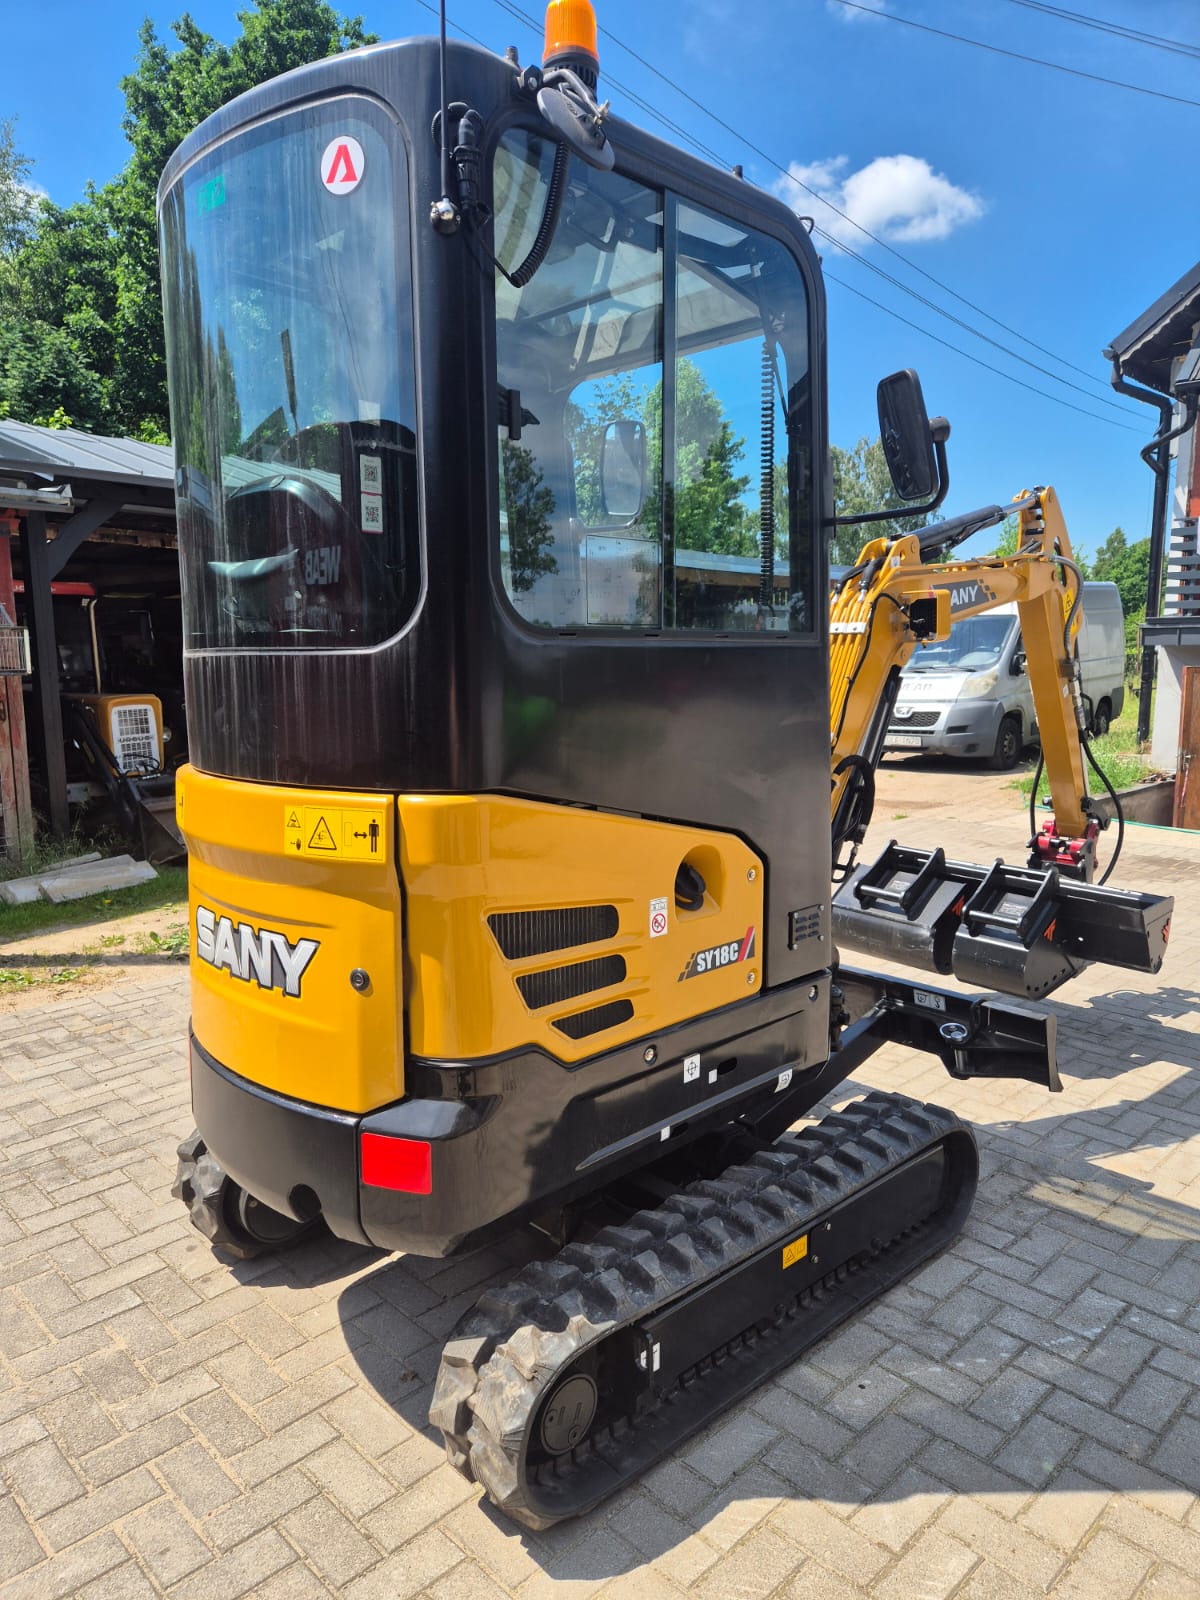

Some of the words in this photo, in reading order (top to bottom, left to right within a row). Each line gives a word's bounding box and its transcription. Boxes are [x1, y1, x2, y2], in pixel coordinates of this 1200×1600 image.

[950, 585, 978, 607] ANY
[196, 904, 321, 998] SANY
[696, 942, 739, 972] SY18C
